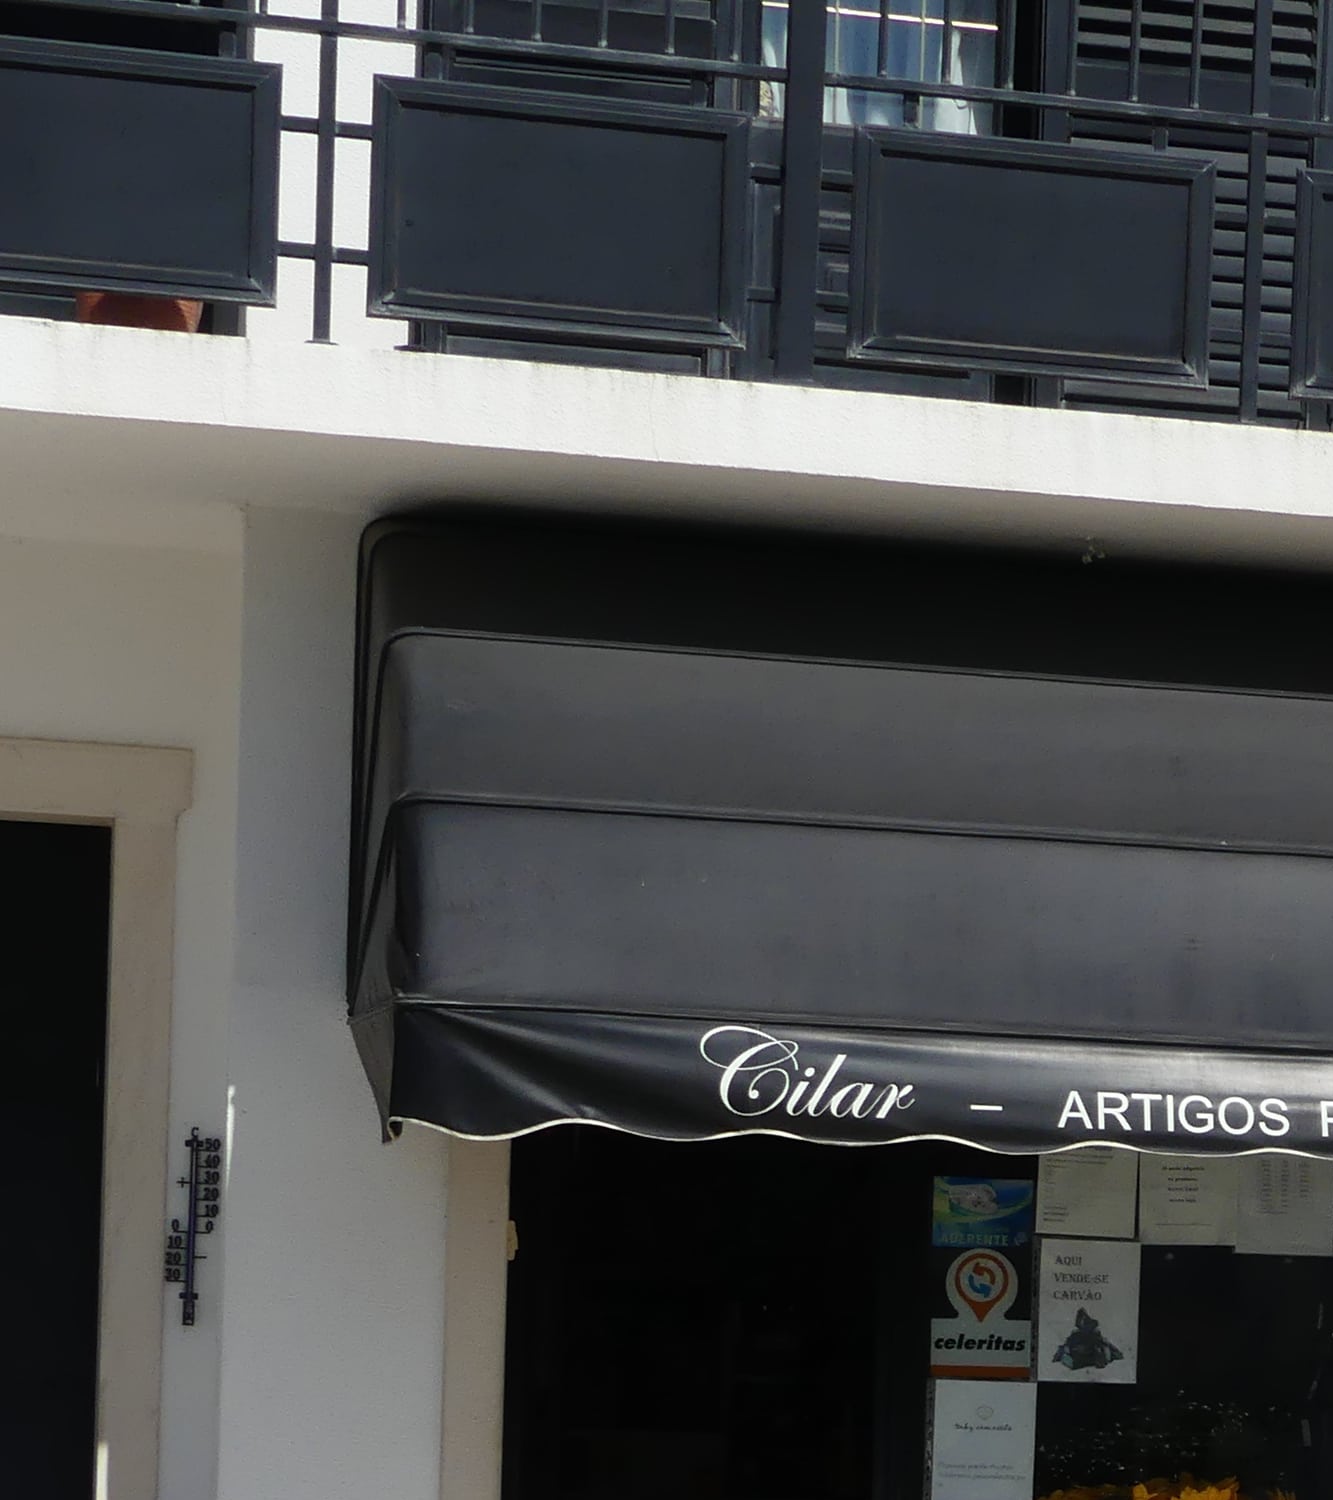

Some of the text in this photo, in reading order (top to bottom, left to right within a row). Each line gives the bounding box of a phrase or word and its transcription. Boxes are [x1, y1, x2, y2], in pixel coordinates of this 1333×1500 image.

[700, 1025, 915, 1119] Cilar
[1057, 1090, 1290, 1137] ARTIGOS
[1055, 1255, 1082, 1267] AQUI
[1053, 1272, 1109, 1284] VENDE-SE
[934, 1333, 1026, 1351] celeritas
